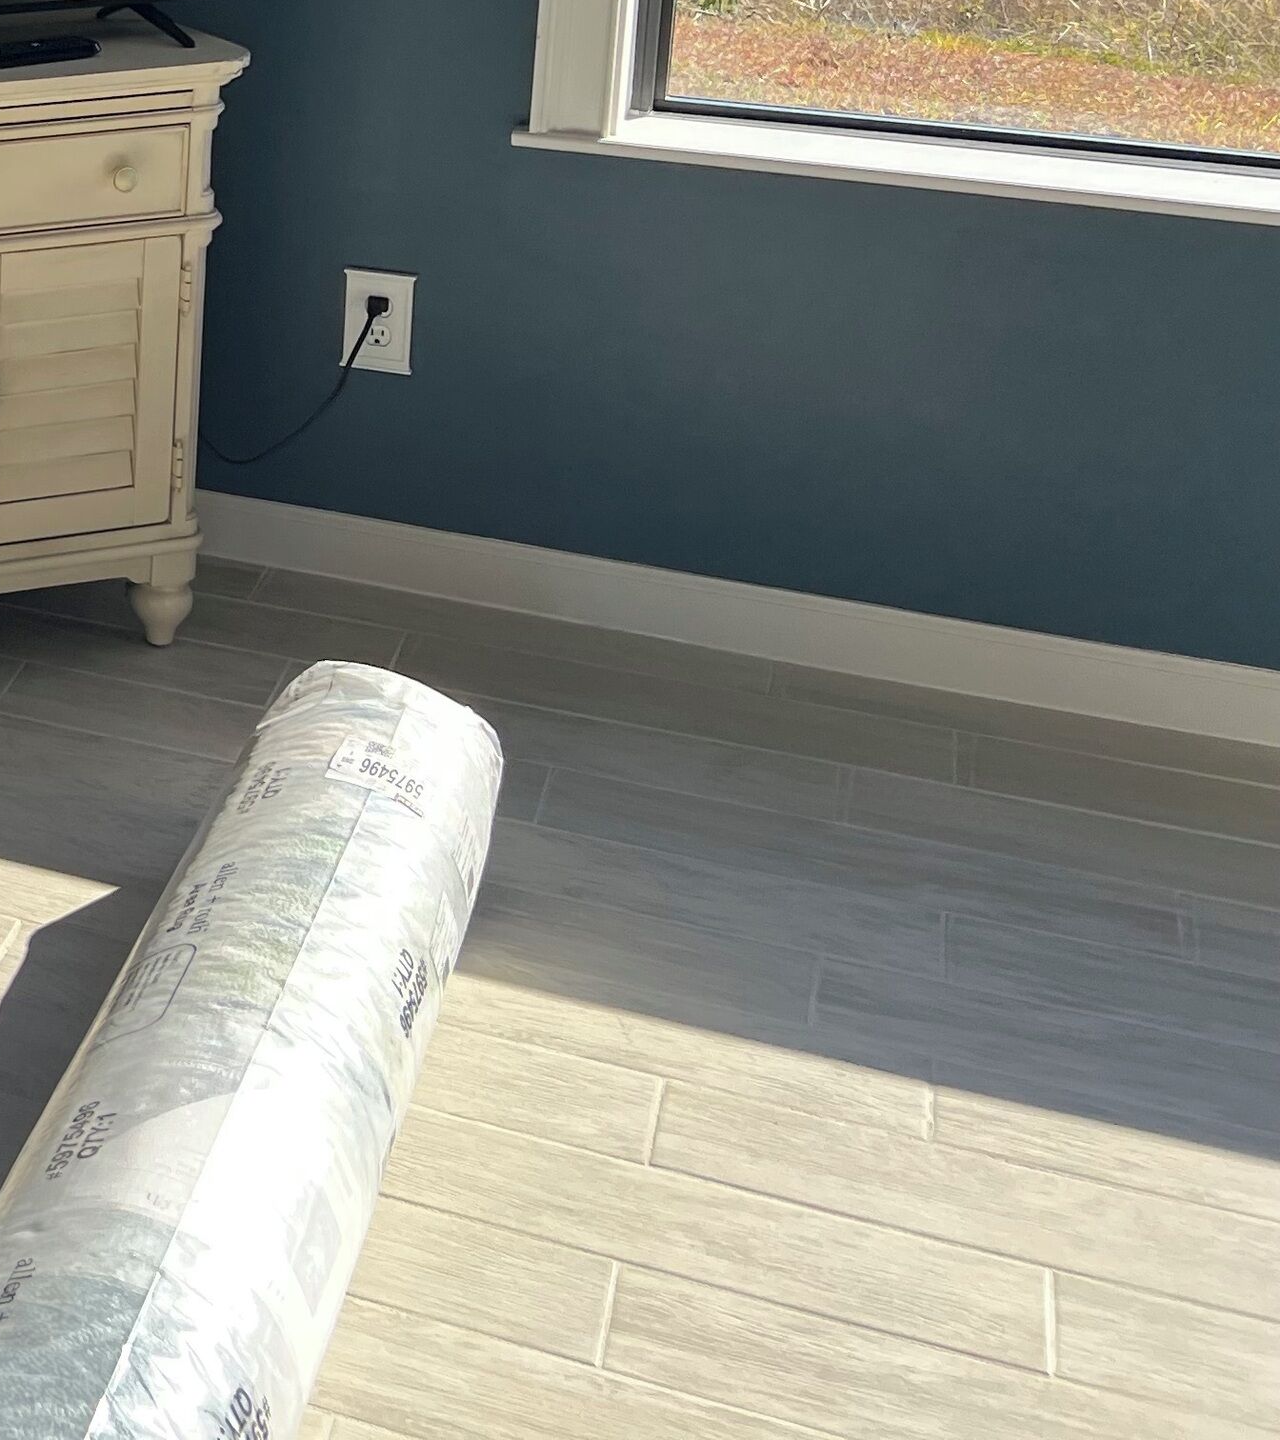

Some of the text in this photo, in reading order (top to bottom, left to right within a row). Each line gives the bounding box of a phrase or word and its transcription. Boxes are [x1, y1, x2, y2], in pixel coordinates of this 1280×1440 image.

[358, 758, 424, 800] 5975496
[208, 861, 239, 893] allen
[45, 1101, 101, 1180] #5975496
[77, 1112, 117, 1159] QTY:1
